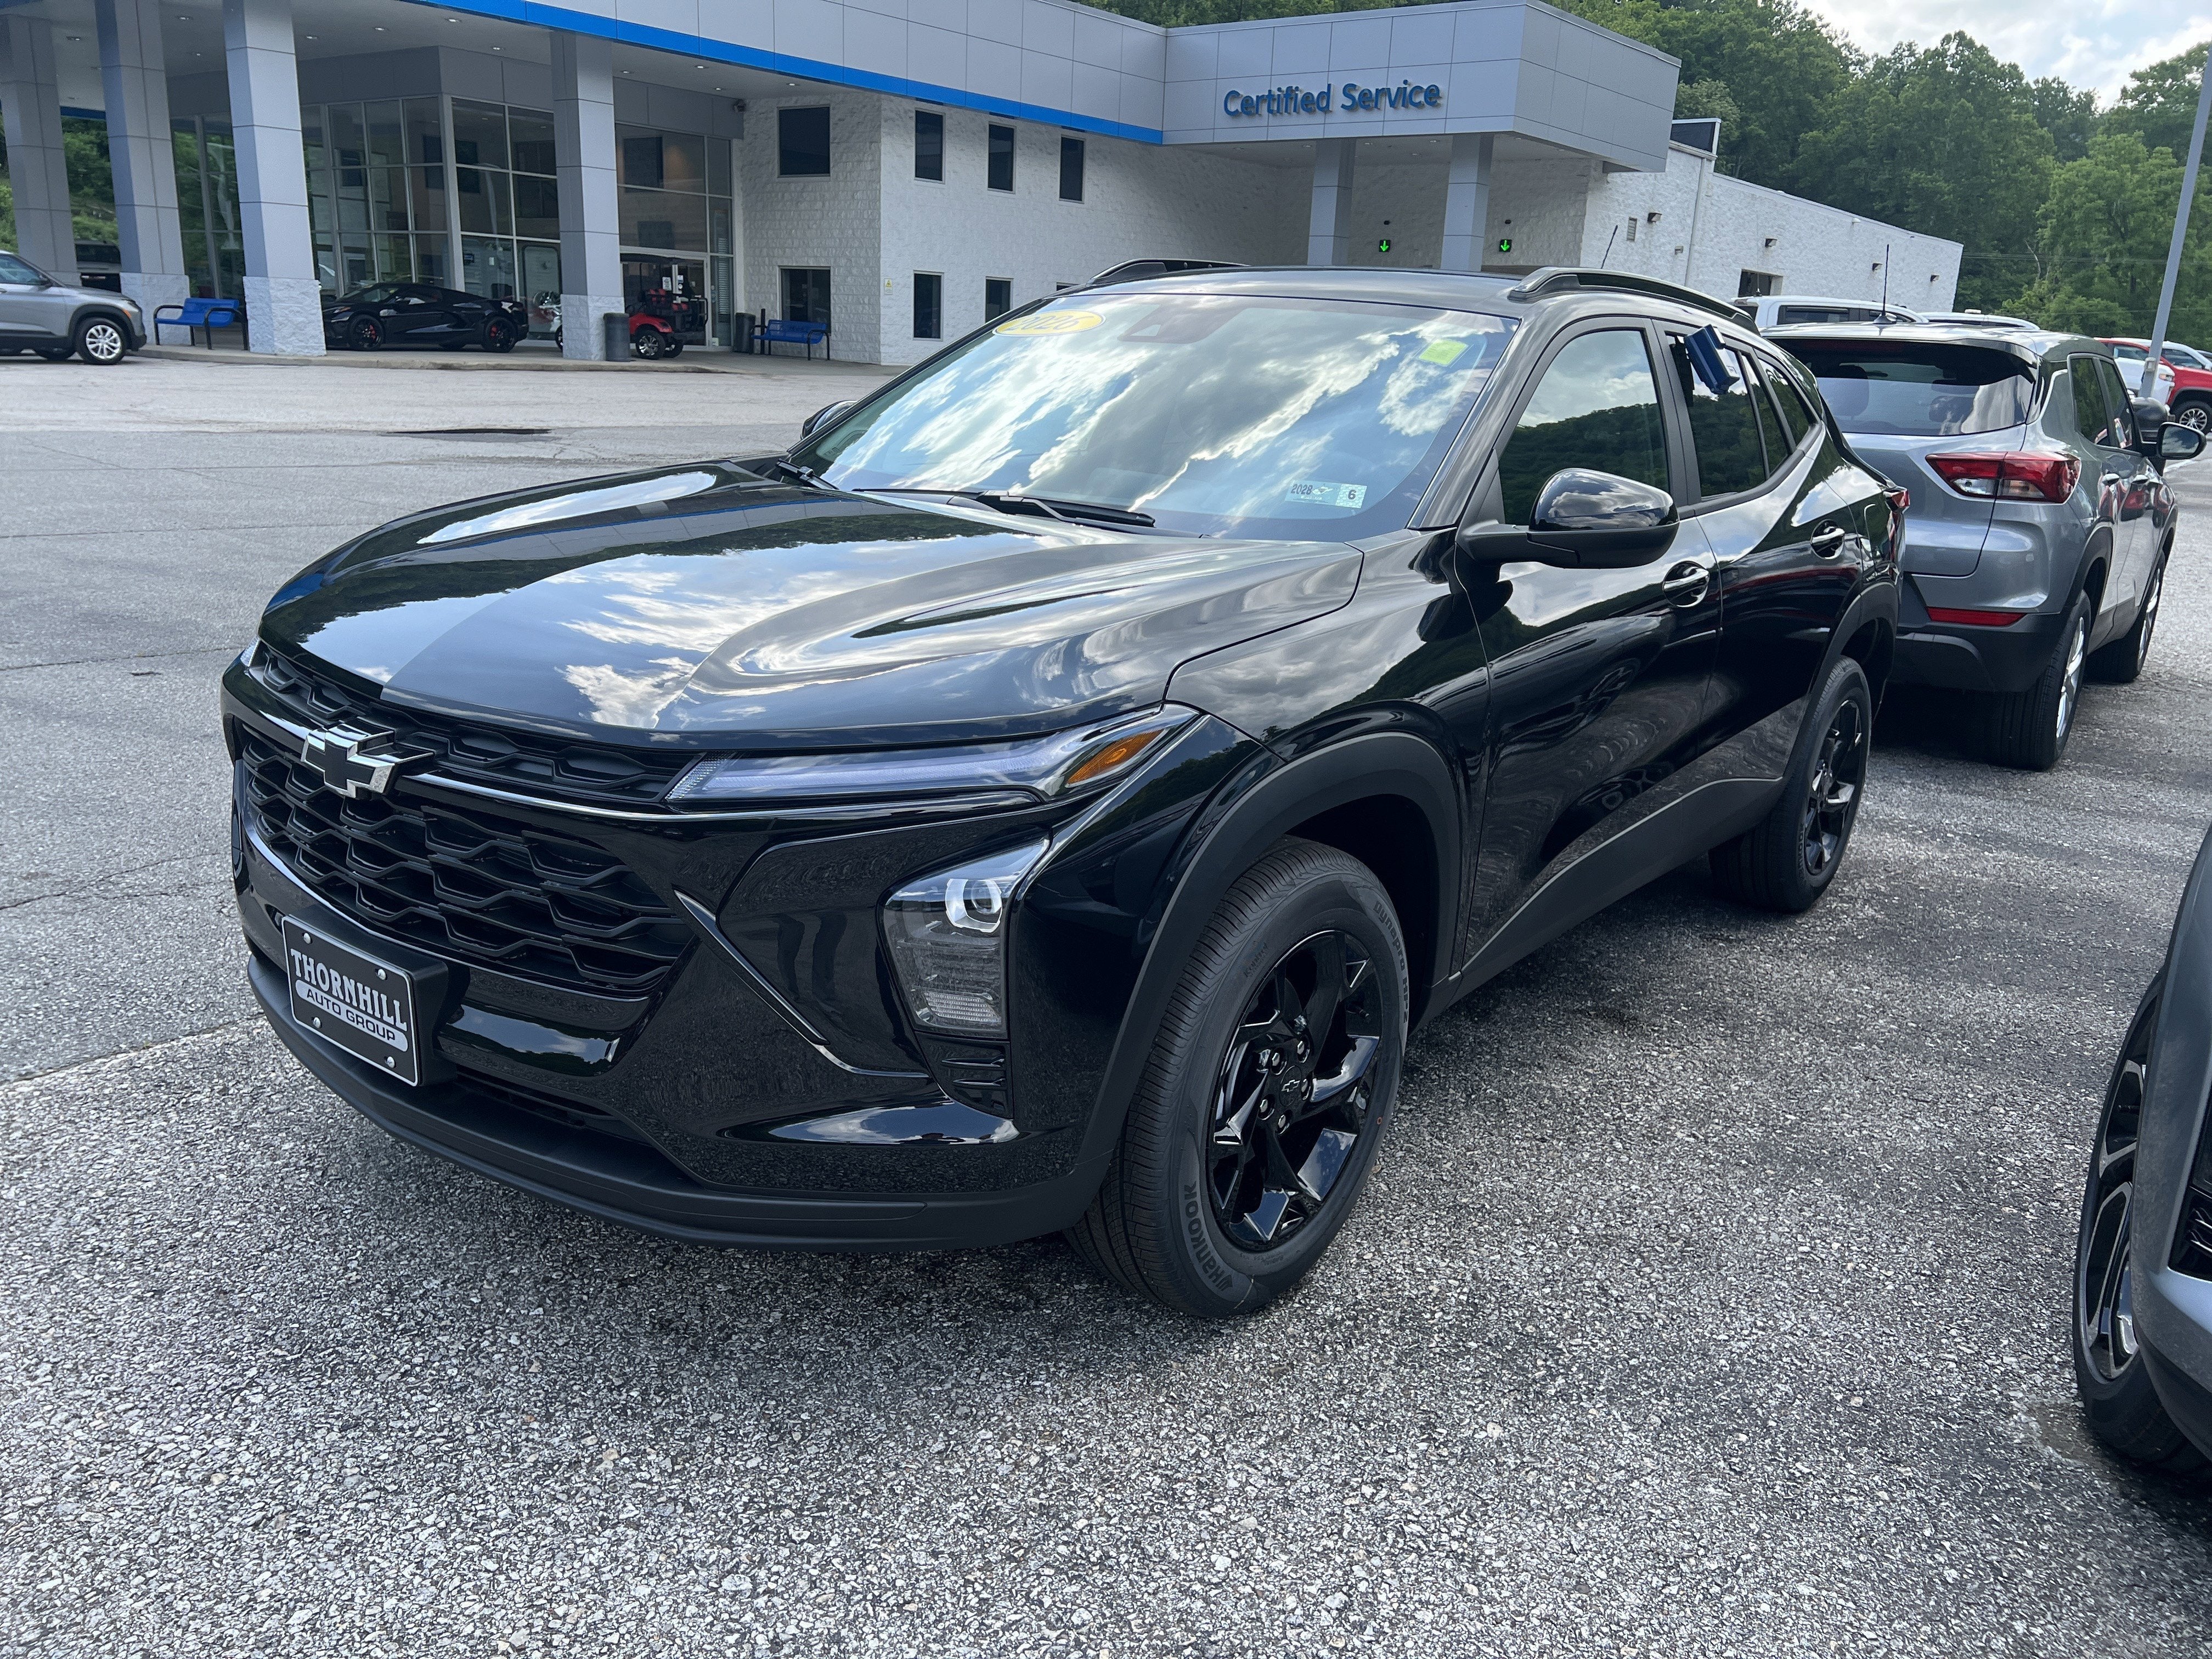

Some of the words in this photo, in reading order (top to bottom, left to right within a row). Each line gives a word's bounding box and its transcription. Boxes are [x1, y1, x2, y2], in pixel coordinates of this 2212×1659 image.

[1223, 83, 1332, 116] Certified
[1340, 79, 1442, 110] Service
[1003, 315, 1094, 331] 2026
[1290, 483, 1314, 495] 2028
[1348, 489, 1357, 500] 6
[290, 949, 408, 1031] THORNHILL
[307, 989, 341, 1015] AUTO
[346, 1009, 395, 1041] GROUP
